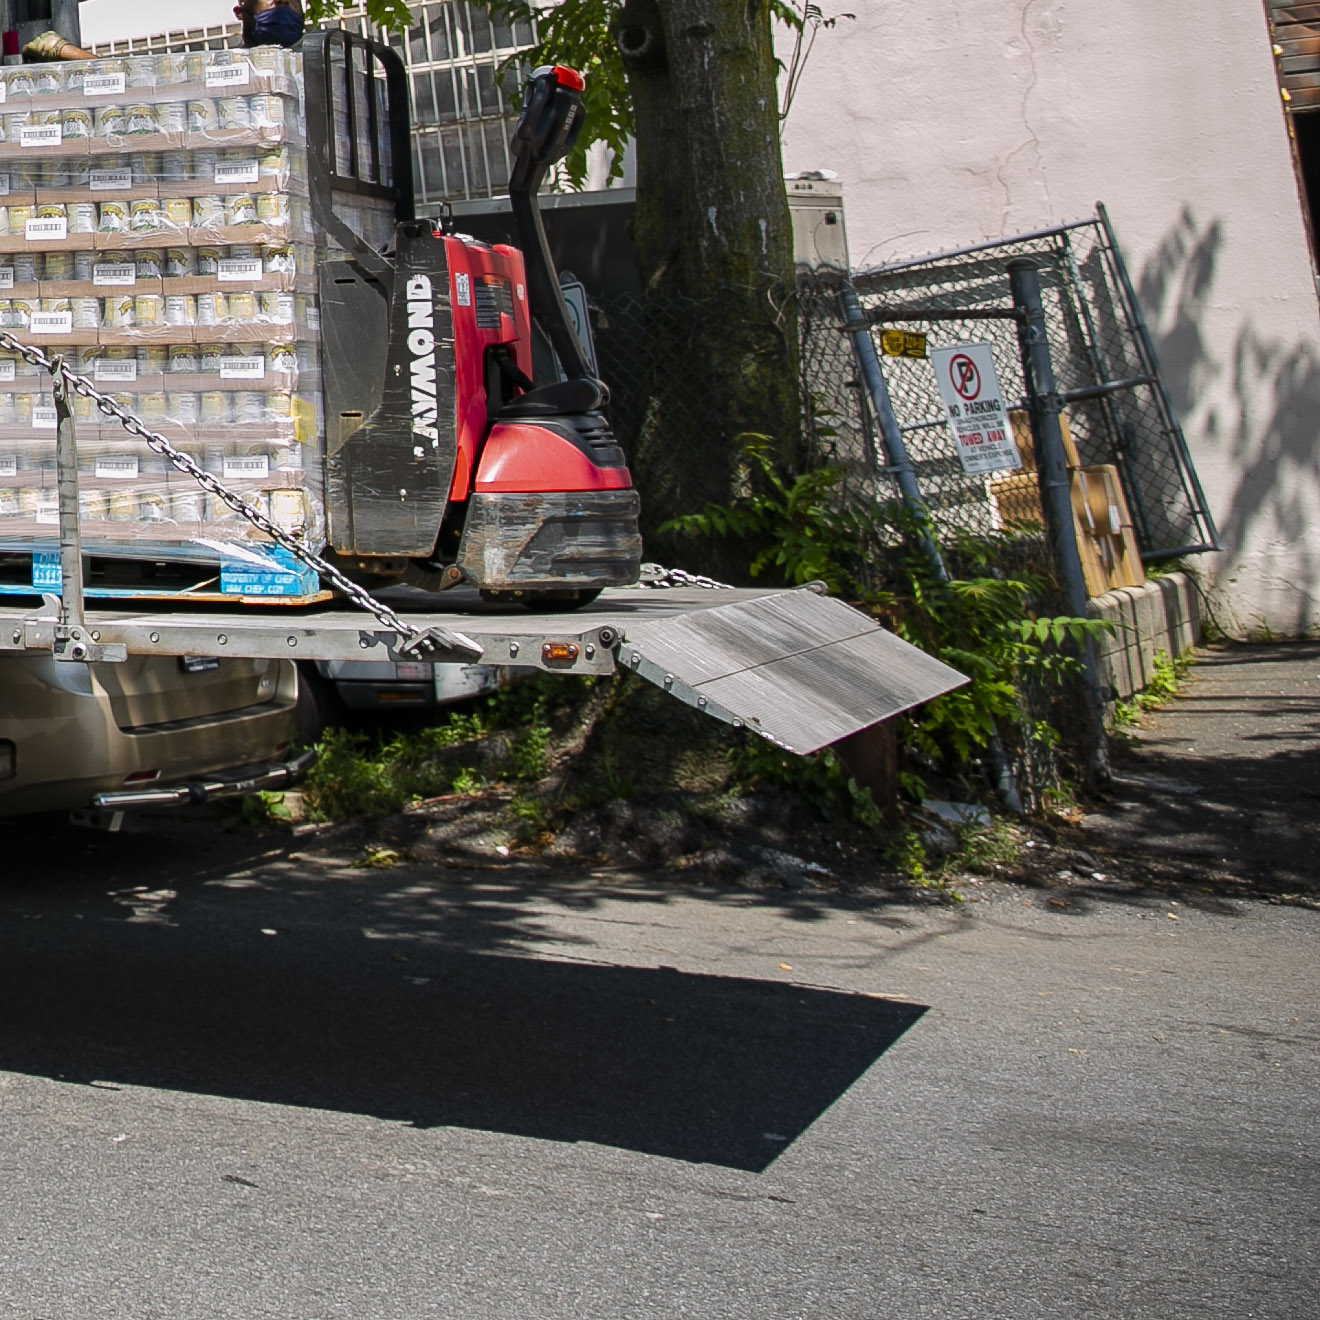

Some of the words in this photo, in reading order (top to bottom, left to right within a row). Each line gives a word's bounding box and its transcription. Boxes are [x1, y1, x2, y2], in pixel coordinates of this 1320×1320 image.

[947, 405, 960, 418] NO
[964, 399, 1001, 415] PARKING
[958, 433, 983, 446] TOWED
[987, 429, 1006, 443] AWAY
